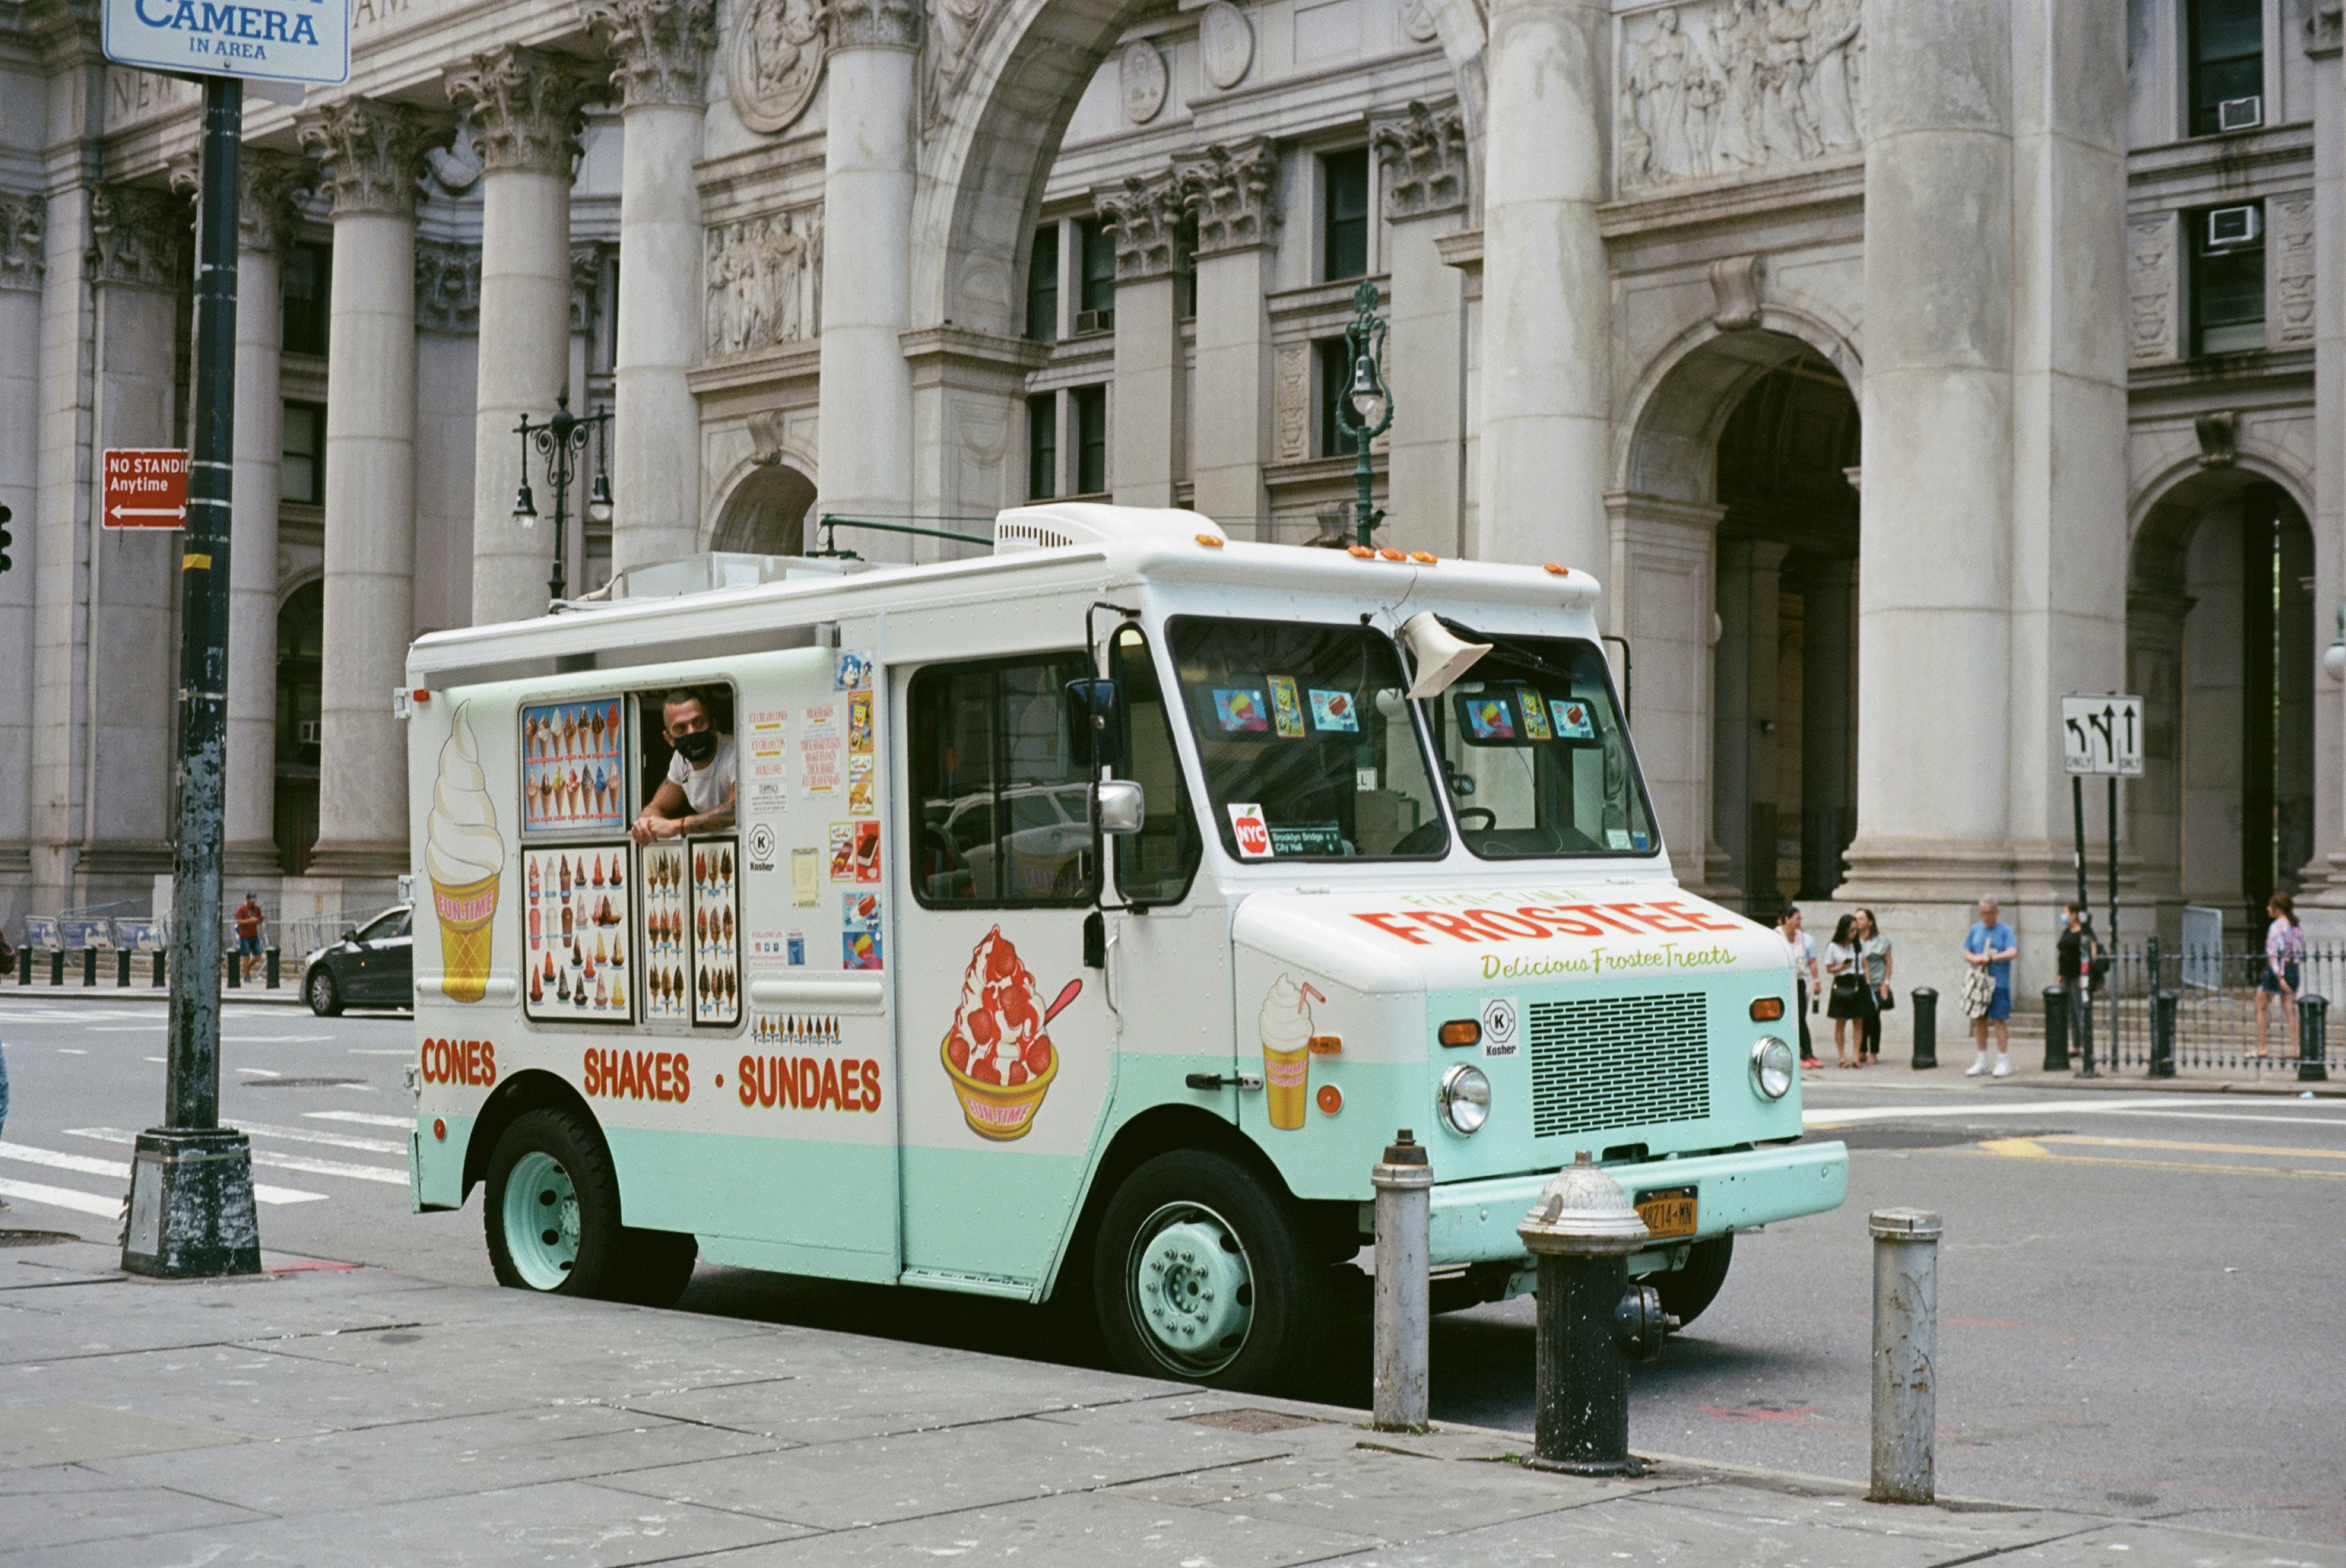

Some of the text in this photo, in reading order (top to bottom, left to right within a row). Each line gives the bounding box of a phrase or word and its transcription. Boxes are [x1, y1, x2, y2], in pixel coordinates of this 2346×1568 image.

[135, 0, 319, 46] CAMERA
[190, 37, 267, 60] IN AREA
[110, 458, 130, 473] NO
[110, 477, 169, 494] Anytime
[757, 836, 766, 849] K
[1237, 825, 1266, 843] NYC
[1272, 832, 1301, 843] Brooklyn
[1301, 832, 1324, 843] Bridge
[1275, 843, 1289, 853] City
[750, 862, 774, 872] Kosher
[437, 890, 494, 923] FUN-TIME
[1348, 901, 1744, 945] FROSTEE
[1481, 942, 1736, 979] Delicious Frostee Treats
[1494, 1014, 1504, 1029] K
[1486, 1045, 1516, 1056] Kosher
[421, 1038, 497, 1086] CONES
[584, 1048, 882, 1113] SHAKES SUNDAES
[964, 1095, 1032, 1126] FUN-TIME
